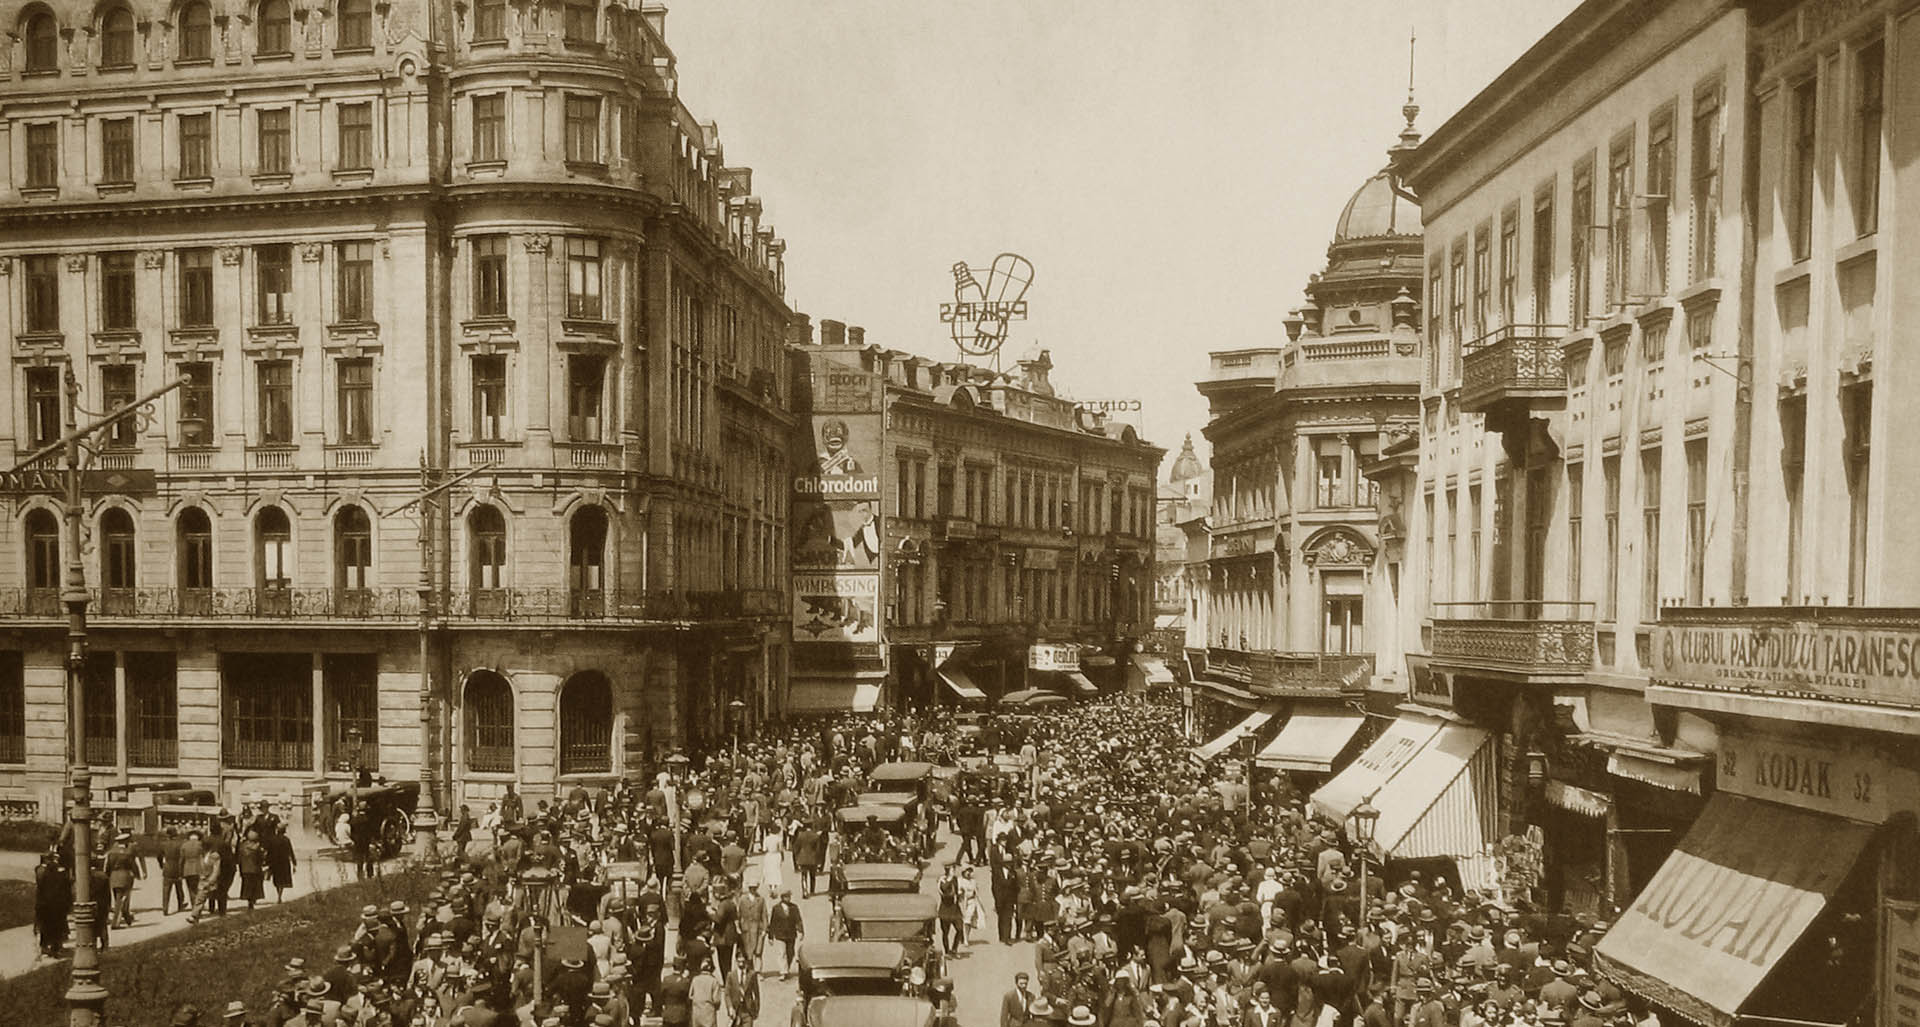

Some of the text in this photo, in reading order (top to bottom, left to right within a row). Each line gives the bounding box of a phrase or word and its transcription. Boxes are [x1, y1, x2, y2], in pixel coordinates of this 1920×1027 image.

[794, 475, 879, 493] Chlorodont
[793, 578, 875, 593] WIMPASSING
[1681, 630, 1726, 665] CLUBUL
[1731, 632, 1817, 671] PARTIDULUI
[1756, 752, 1832, 799] KODAK
